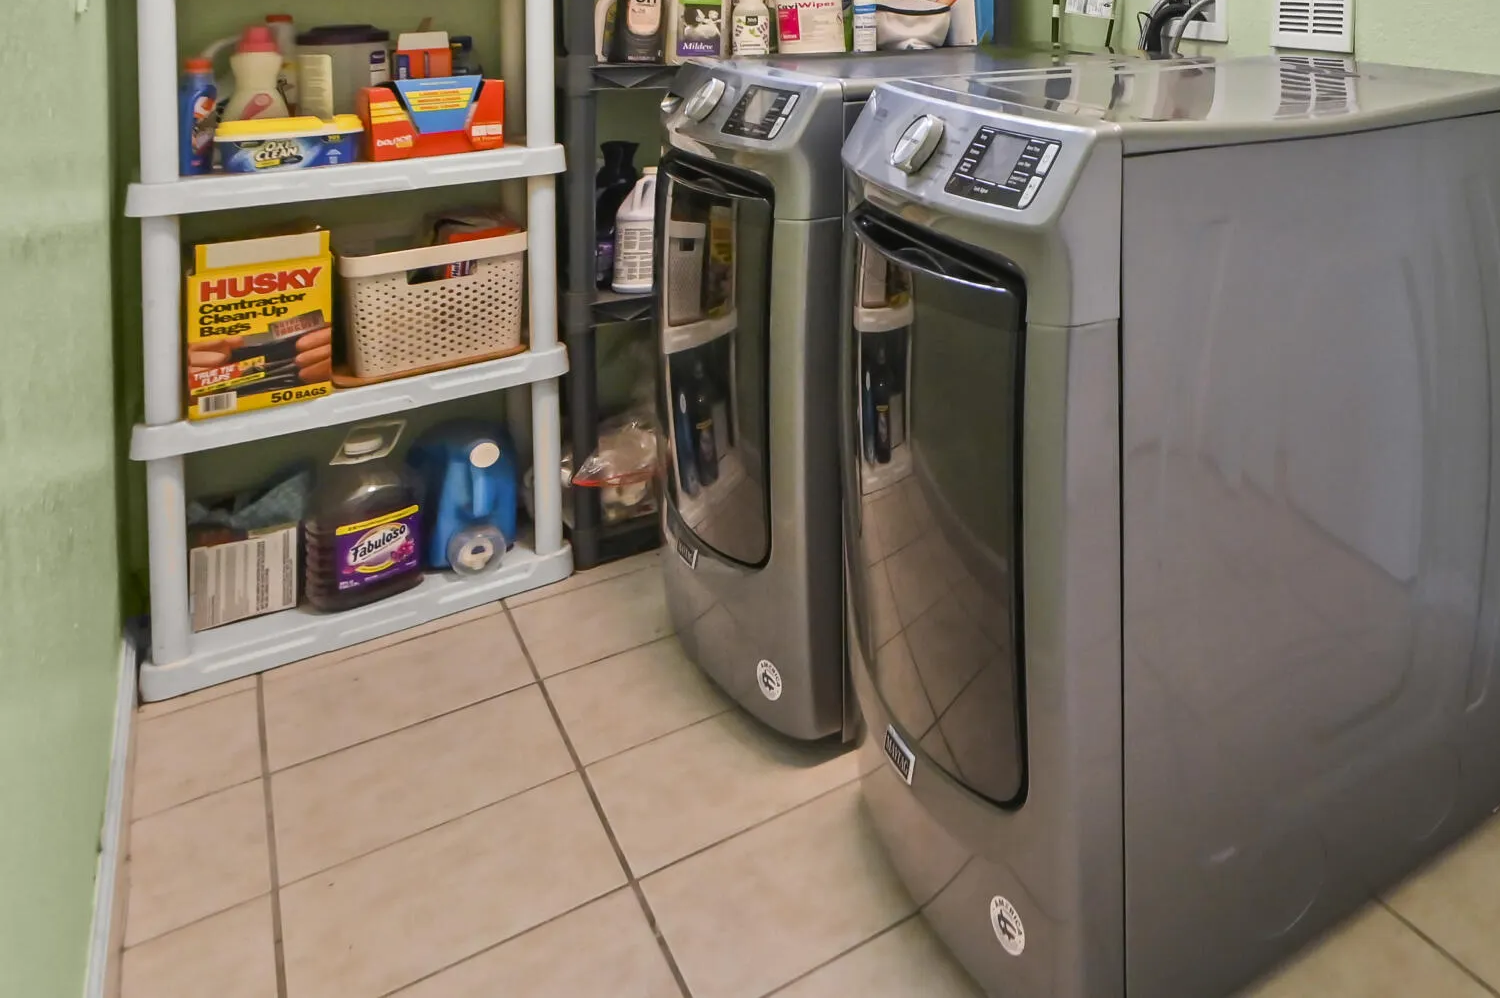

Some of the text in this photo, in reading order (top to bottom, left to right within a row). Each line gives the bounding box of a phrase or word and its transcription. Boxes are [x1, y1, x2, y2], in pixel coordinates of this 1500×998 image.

[682, 42, 715, 51] Mildew
[376, 134, 413, 147] bounce
[255, 146, 299, 162] CLEAN
[200, 266, 323, 303] HUSKY
[199, 292, 306, 315] Contractor
[199, 306, 289, 326] Clean-Up
[200, 322, 252, 337] Bags
[193, 368, 221, 382] TRUE
[201, 373, 231, 387] FLAPS
[271, 386, 327, 403] 50 BAGS
[351, 525, 406, 563] Fabuloso
[885, 733, 909, 778] MAYTAG
